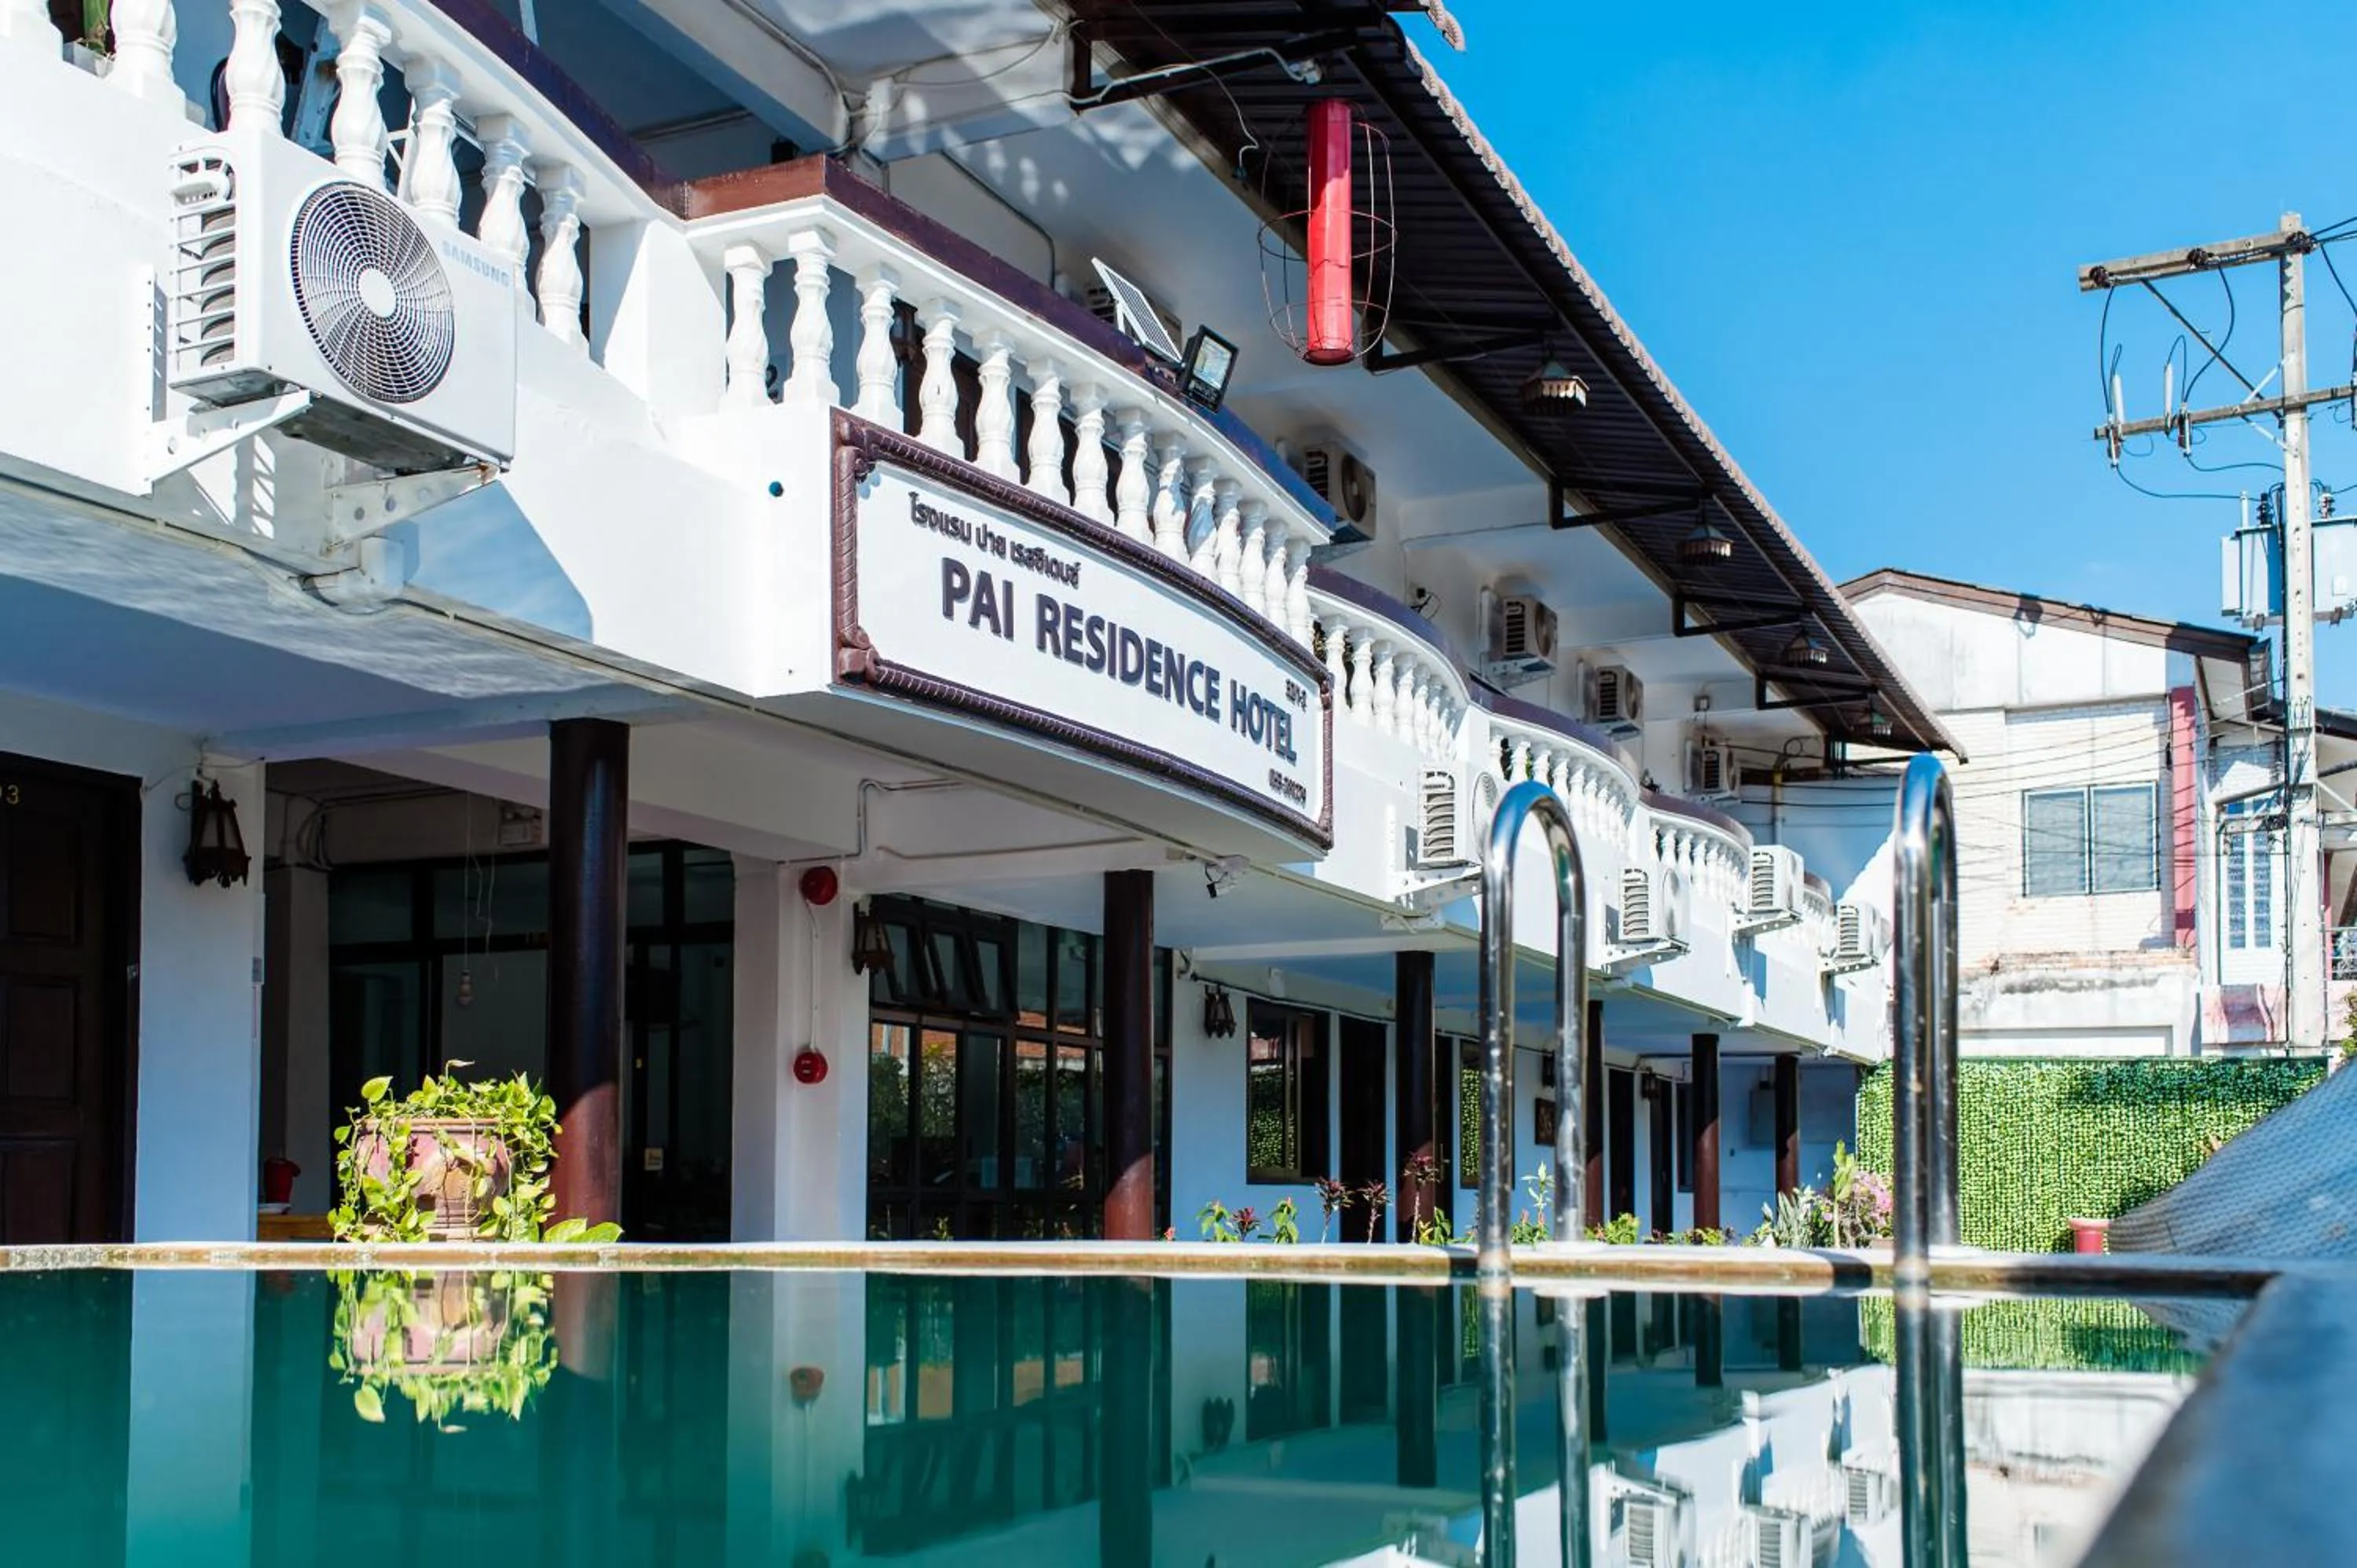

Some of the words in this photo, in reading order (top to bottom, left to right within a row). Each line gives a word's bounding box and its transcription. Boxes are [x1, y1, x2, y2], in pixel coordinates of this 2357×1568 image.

[442, 240, 510, 287] SAMSUNG
[908, 491, 972, 545] โรงแรม
[976, 523, 1006, 559] ปาย
[942, 557, 1014, 642] PAI
[1036, 593, 1220, 724] RESIDENCE
[1230, 678, 1297, 765] HOTEL
